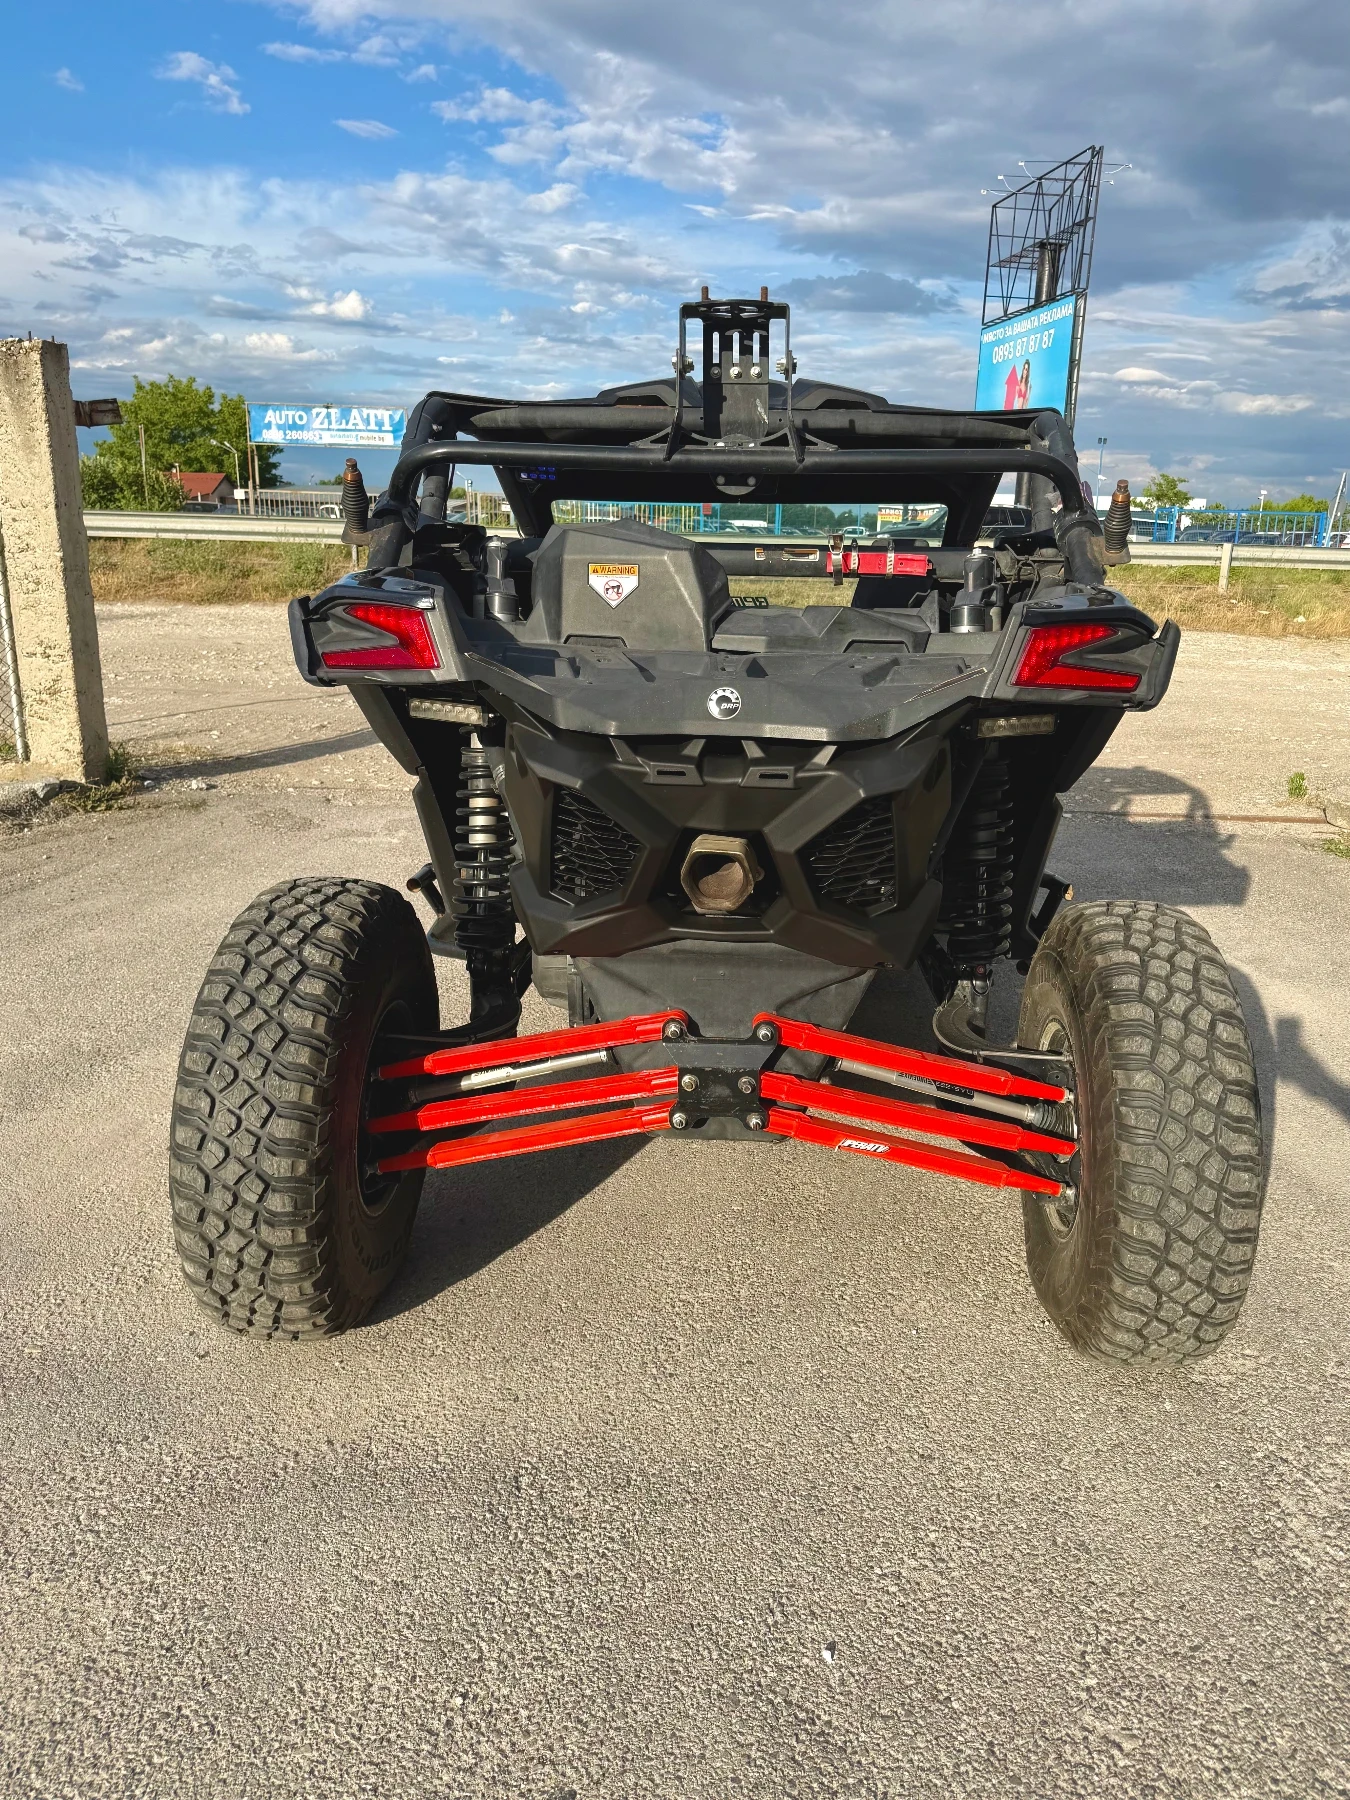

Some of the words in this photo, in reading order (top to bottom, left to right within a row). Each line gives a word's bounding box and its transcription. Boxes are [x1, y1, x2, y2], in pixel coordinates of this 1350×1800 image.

[983, 328, 1004, 343] МЯСТО
[1005, 325, 1013, 337] ЗА
[1013, 316, 1038, 334] ВАШАТА
[1040, 303, 1072, 325] РЕКЛАМА
[993, 342, 1014, 364] 0893
[1015, 336, 1027, 357] 87
[1028, 333, 1041, 354] 87
[1041, 328, 1055, 349] 87
[264, 410, 307, 424] AUTO
[312, 408, 393, 430] ZLATI
[600, 566, 636, 575] WARNING
